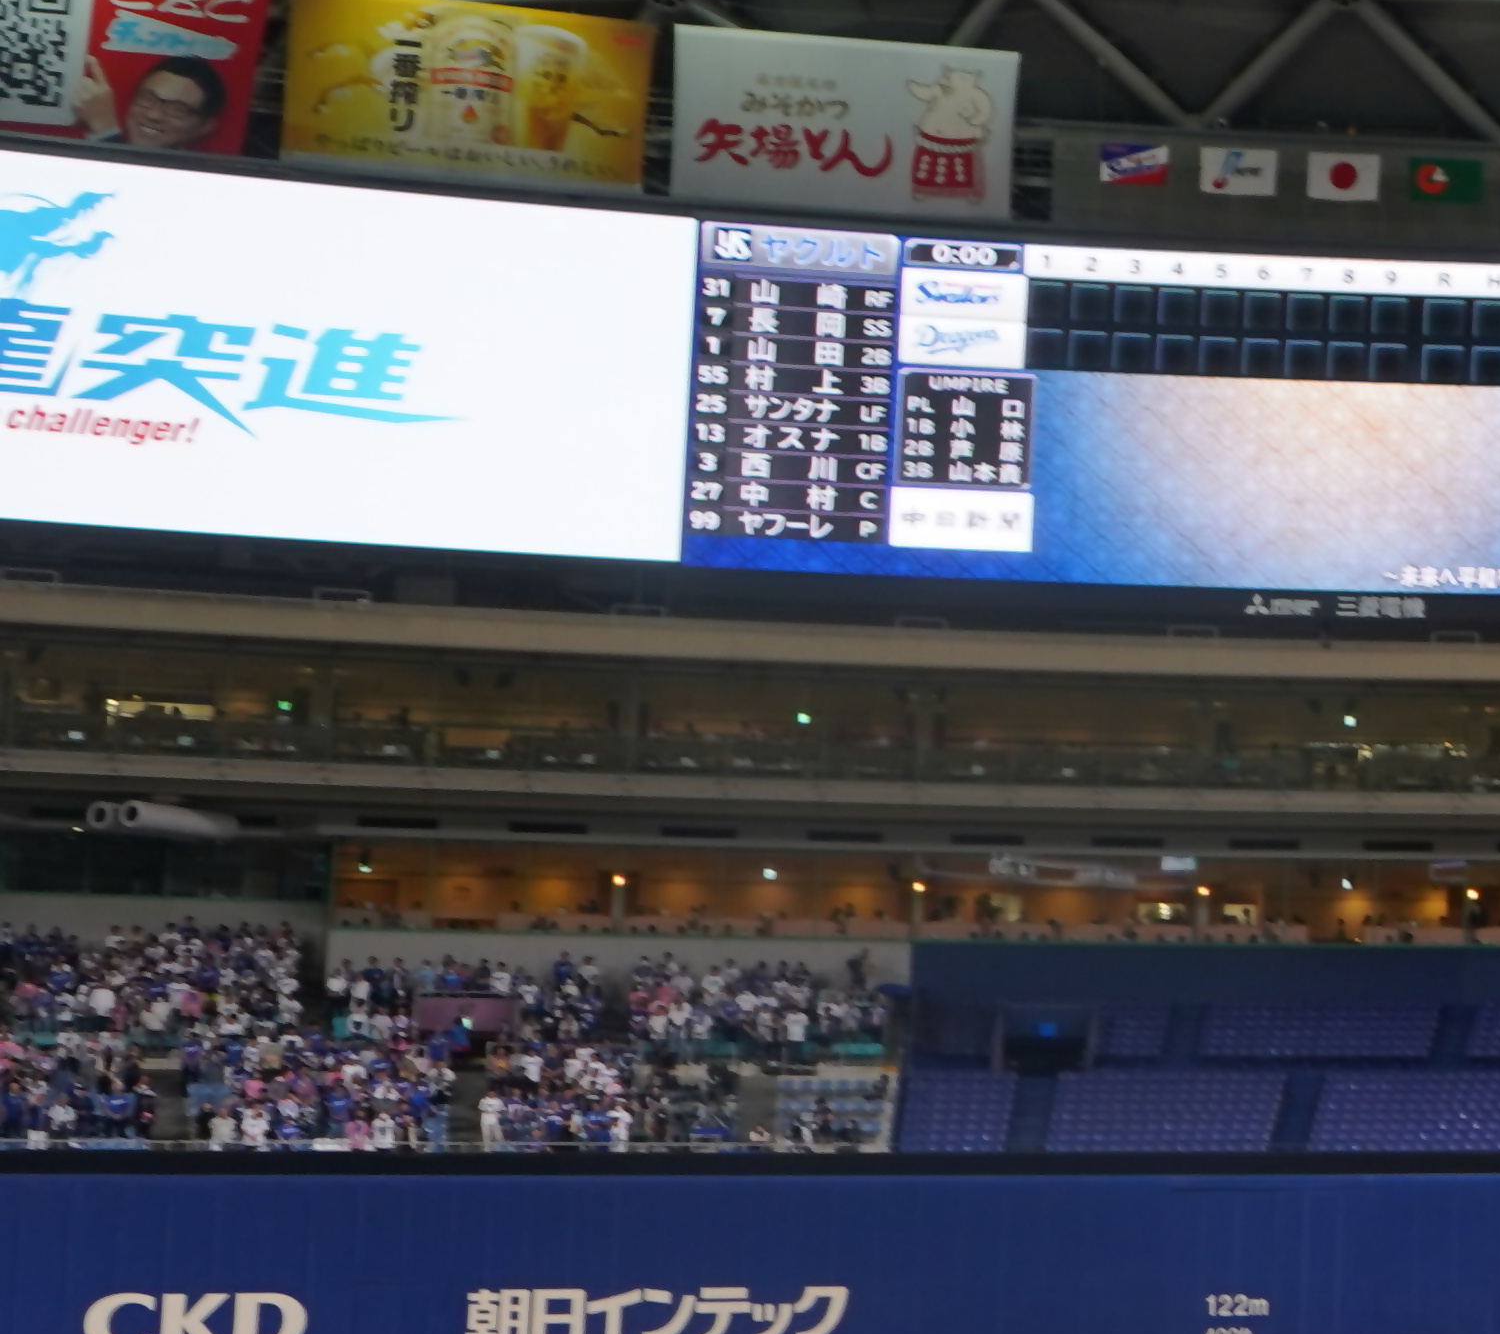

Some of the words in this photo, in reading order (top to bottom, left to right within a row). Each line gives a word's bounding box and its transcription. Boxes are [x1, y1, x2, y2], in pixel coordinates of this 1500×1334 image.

[390, 39, 423, 132] 一番搾り
[695, 118, 892, 177] 矢場とん
[762, 235, 885, 266] ヤクルト
[932, 245, 998, 266] 0:00
[1043, 255, 1050, 267] 1
[1087, 257, 1097, 272] 2
[1131, 259, 1141, 274] 3
[1172, 262, 1184, 276] 4
[1216, 264, 1227, 278] 5
[1258, 266, 1269, 280] 6
[1303, 268, 1312, 282] 7
[1343, 270, 1354, 284] 8
[1386, 271, 1397, 285] 9
[1438, 273, 1450, 286] R
[1488, 275, 1500, 287] H
[702, 278, 730, 298] 31
[706, 307, 727, 326] 7
[863, 319, 892, 338] SS
[706, 336, 720, 355] 1
[748, 337, 844, 367] 山田
[698, 366, 728, 385] 55
[745, 365, 843, 396] 村上
[928, 376, 1008, 395] UMPIRE
[696, 394, 727, 414] 25
[744, 396, 840, 422] サンタナ
[907, 396, 935, 414] PL
[952, 396, 1025, 418] 山口
[5, 405, 200, 445] challenger!
[696, 423, 726, 443] 13
[743, 425, 840, 450] オスナ
[699, 453, 717, 471] 3
[741, 453, 837, 481] 西川
[691, 482, 723, 501] 27
[740, 482, 837, 511] 中村
[860, 491, 878, 509] C
[690, 510, 720, 531] 99
[738, 511, 834, 538] ヤフーレ
[859, 521, 877, 537] P
[1205, 1294, 1269, 1318] 122m
